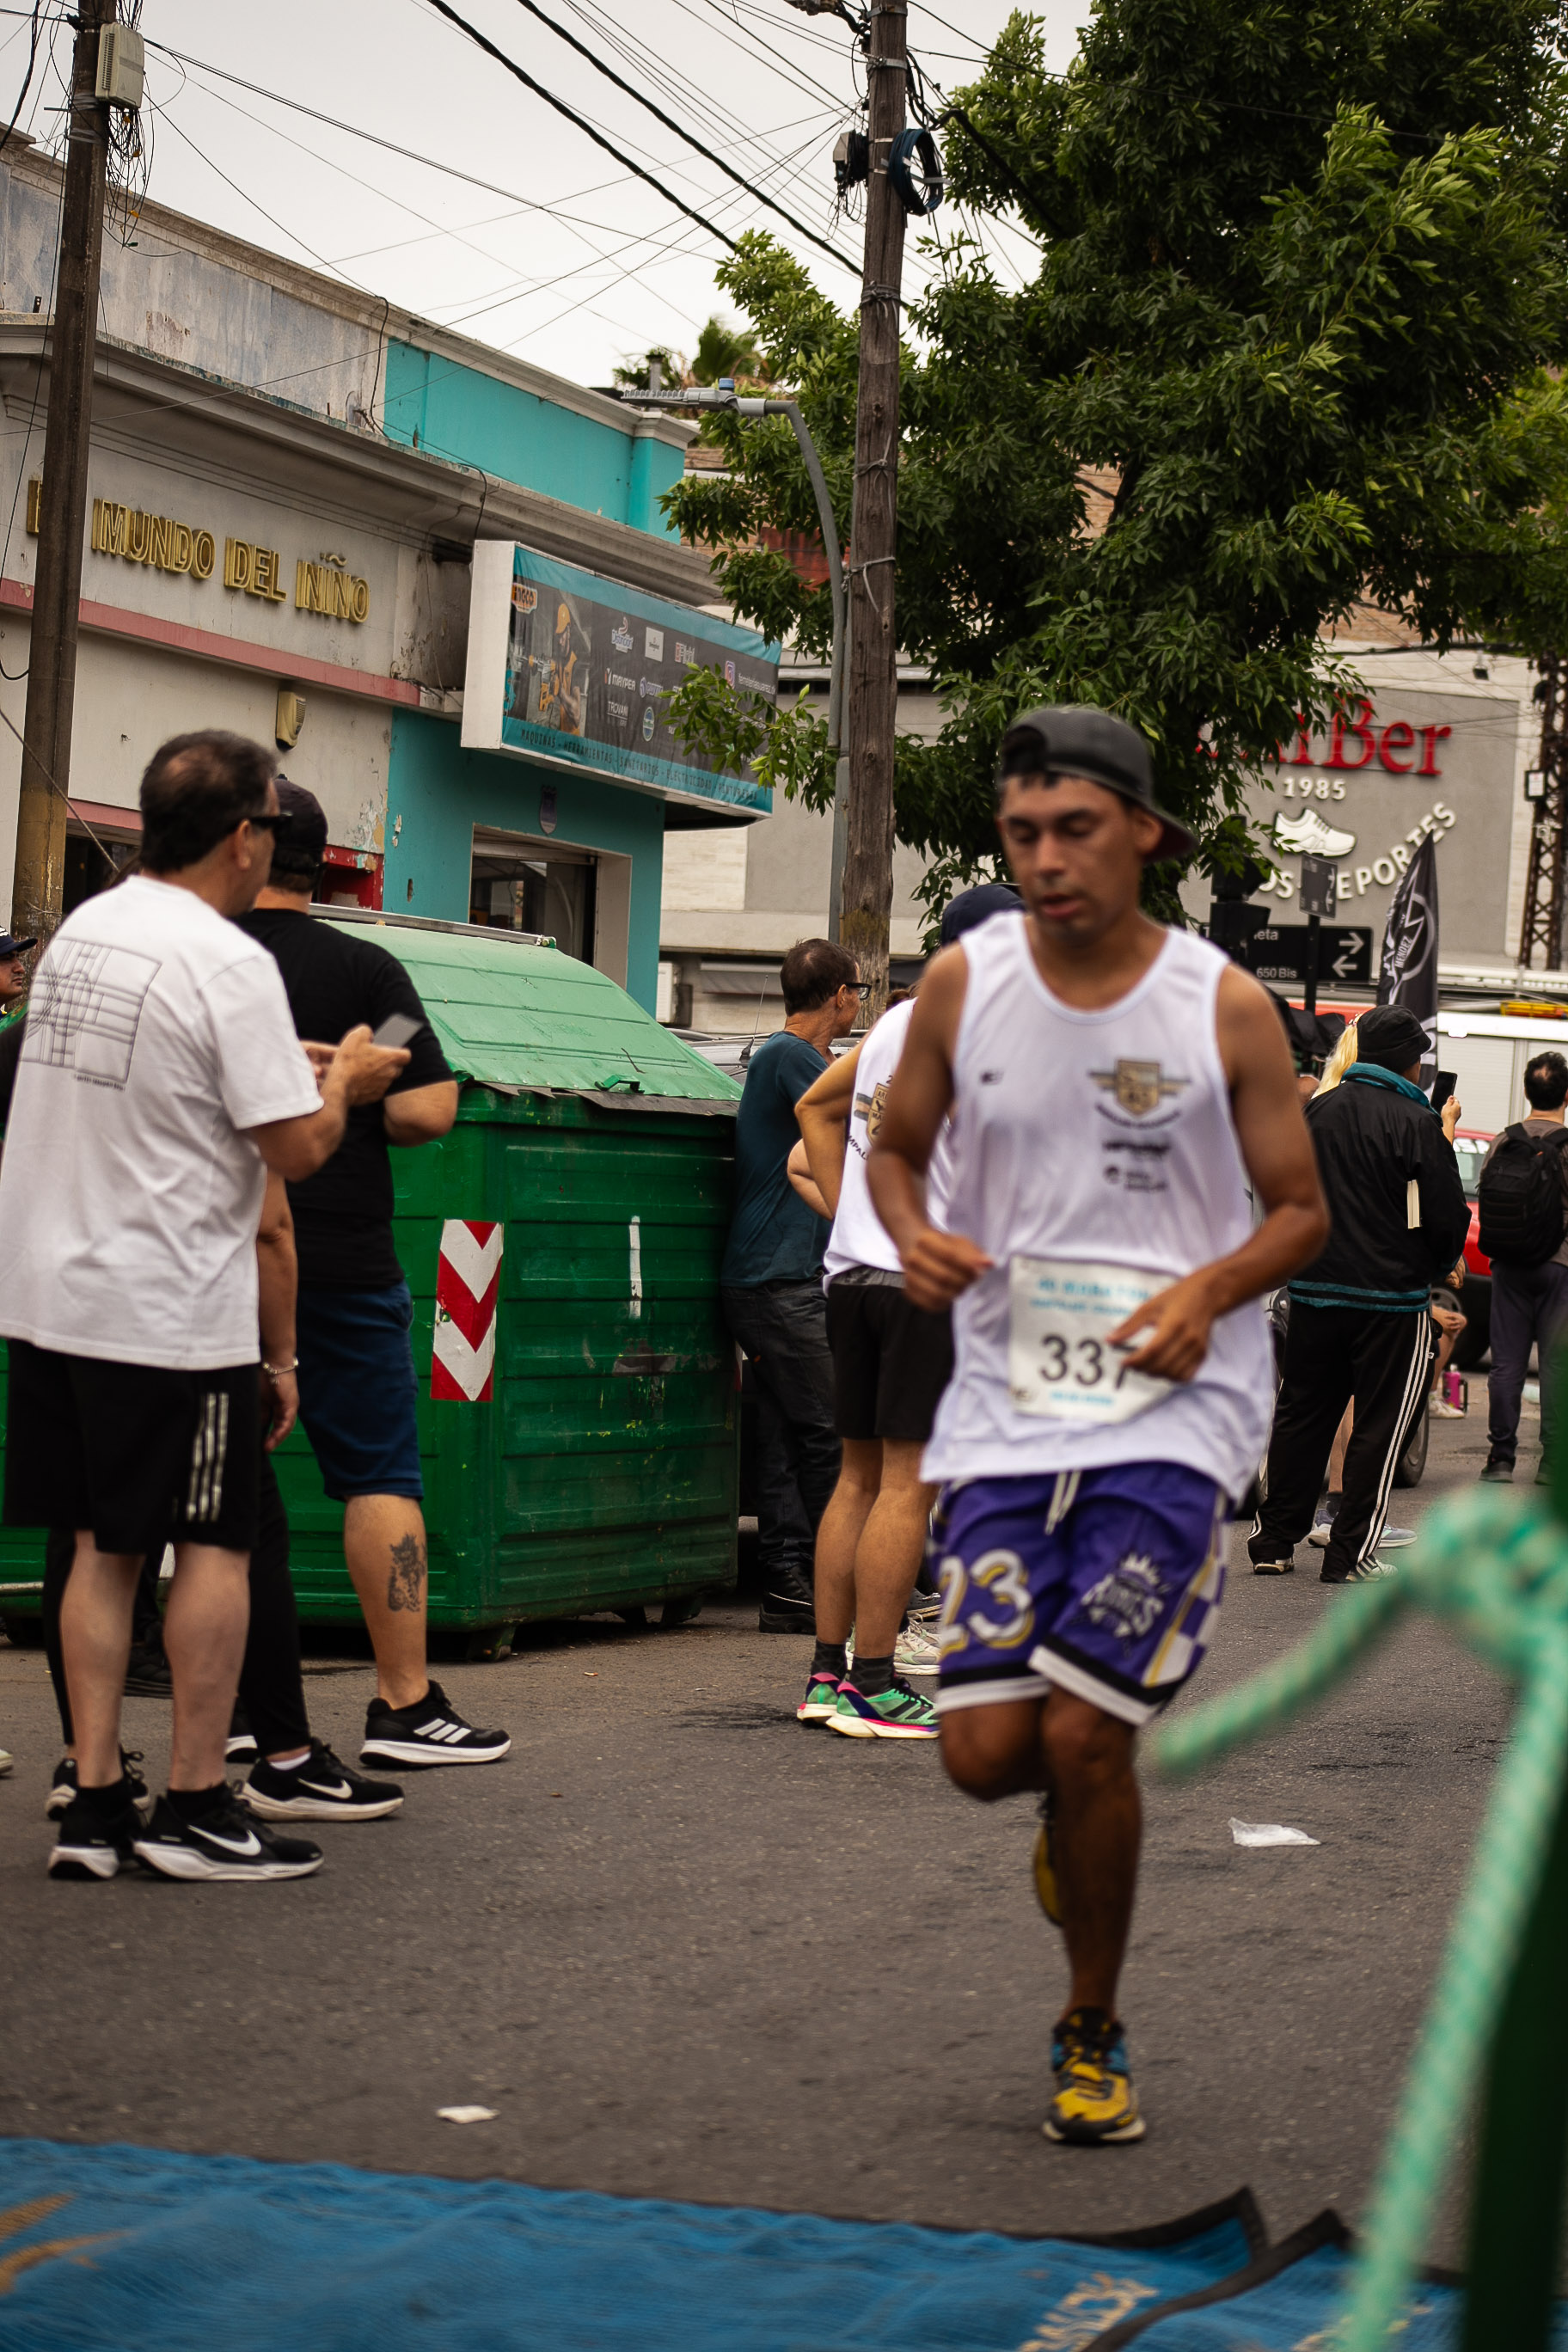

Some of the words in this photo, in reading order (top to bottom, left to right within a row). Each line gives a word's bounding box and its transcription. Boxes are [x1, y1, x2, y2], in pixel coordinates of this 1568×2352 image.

[92, 498, 216, 579] MUNDO
[224, 536, 287, 602] DEL
[296, 551, 371, 623] NIÑO
[521, 729, 556, 749] MAQUINAS
[563, 740, 613, 764] HERRAMIENTAS
[619, 756, 659, 777] SANITARIOS
[1283, 775, 1347, 800] 1985
[1335, 801, 1457, 900] EPORTES
[1278, 967, 1298, 979] Bis
